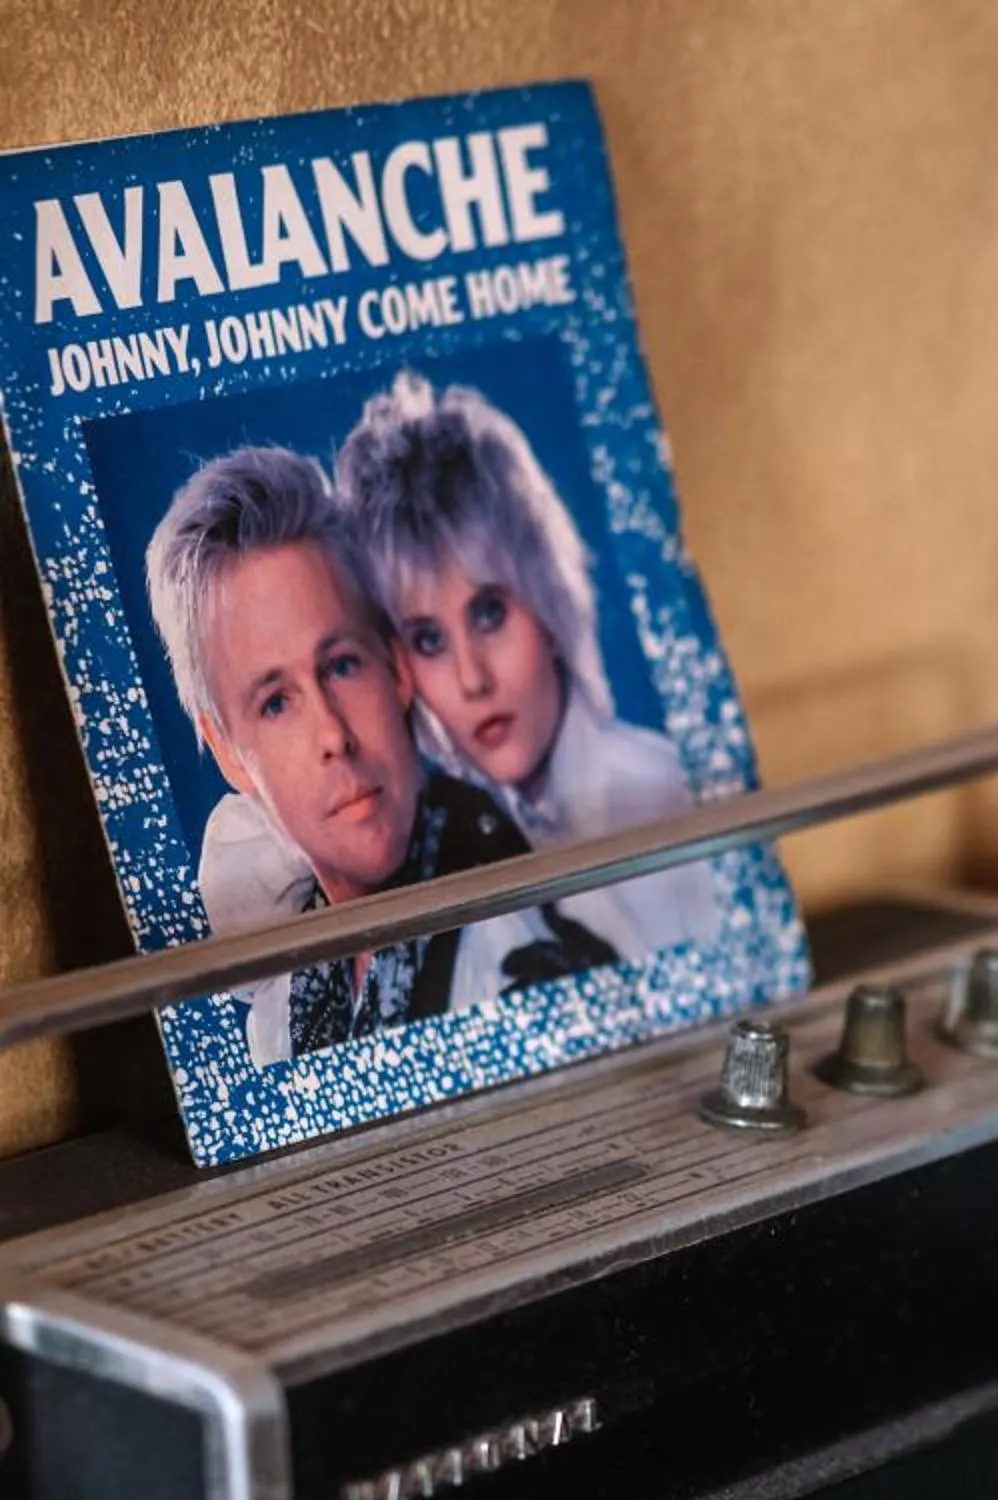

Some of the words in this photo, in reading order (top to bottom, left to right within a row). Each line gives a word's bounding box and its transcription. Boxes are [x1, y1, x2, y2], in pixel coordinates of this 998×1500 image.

[35, 123, 565, 324] AVALANCHE
[47, 324, 201, 396] JOHNNY,
[206, 297, 348, 367] JOHNNY
[357, 277, 464, 338] COME
[465, 255, 576, 319] HOME
